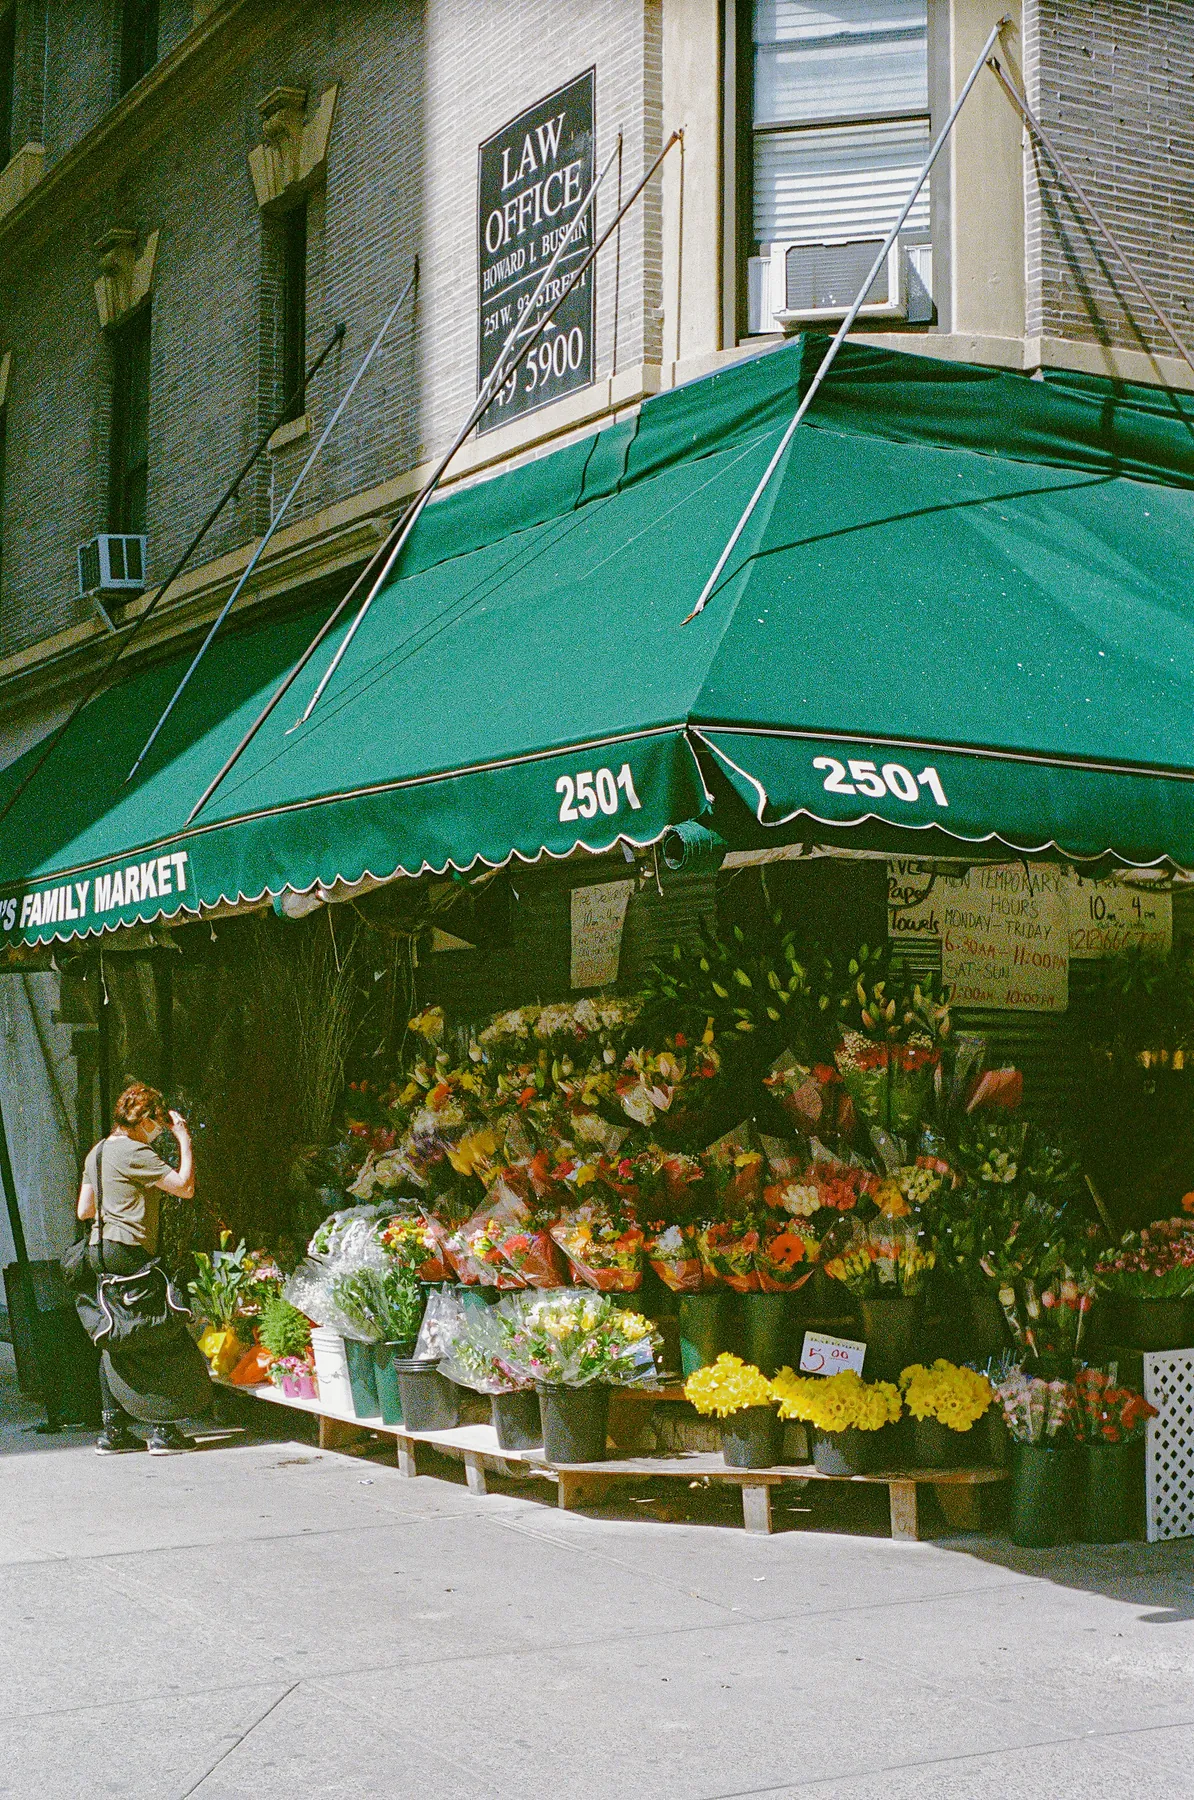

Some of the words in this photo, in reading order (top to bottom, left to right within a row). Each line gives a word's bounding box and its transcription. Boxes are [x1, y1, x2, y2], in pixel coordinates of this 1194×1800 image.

[501, 112, 566, 191] LAW
[485, 159, 582, 253] OFFICE
[483, 248, 526, 292] HOWARD
[484, 311, 500, 338] 251
[500, 304, 513, 326] W.
[525, 327, 584, 392] 5900
[556, 763, 642, 823] 2501
[813, 756, 950, 807] 2501
[19, 880, 90, 928] FAMILY
[94, 851, 188, 913] MARKET
[980, 867, 1062, 893] TEMPORARY
[889, 910, 940, 934] Towels
[990, 895, 1040, 919] HOURS
